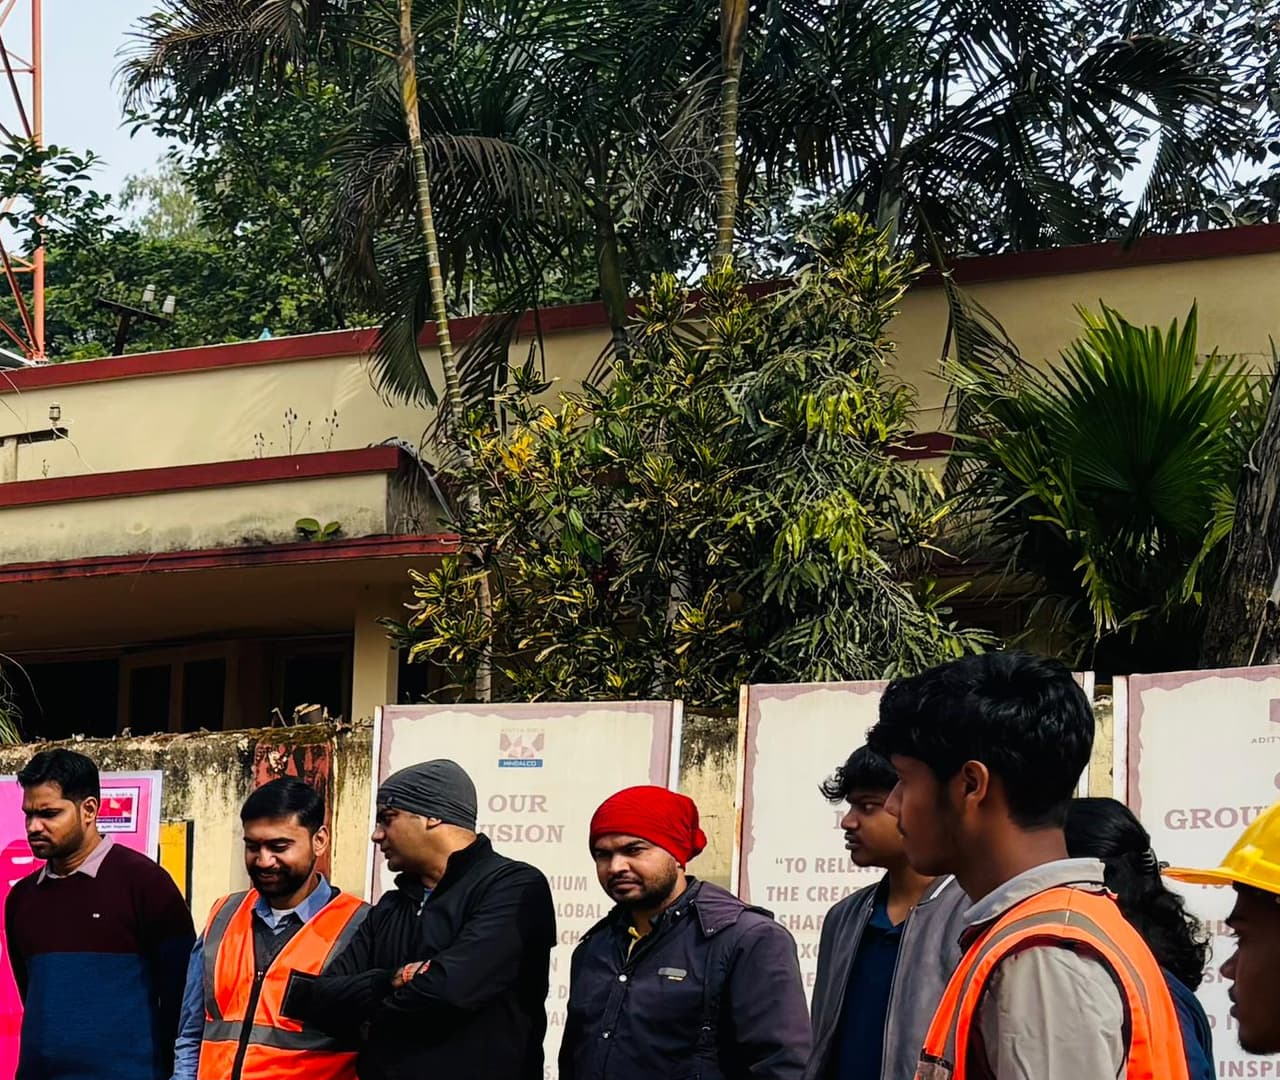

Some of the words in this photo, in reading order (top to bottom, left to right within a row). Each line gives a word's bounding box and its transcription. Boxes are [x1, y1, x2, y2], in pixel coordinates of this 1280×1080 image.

[487, 794, 549, 813] OUR
[766, 886, 799, 902] THE
[557, 903, 603, 919] LOBAL
